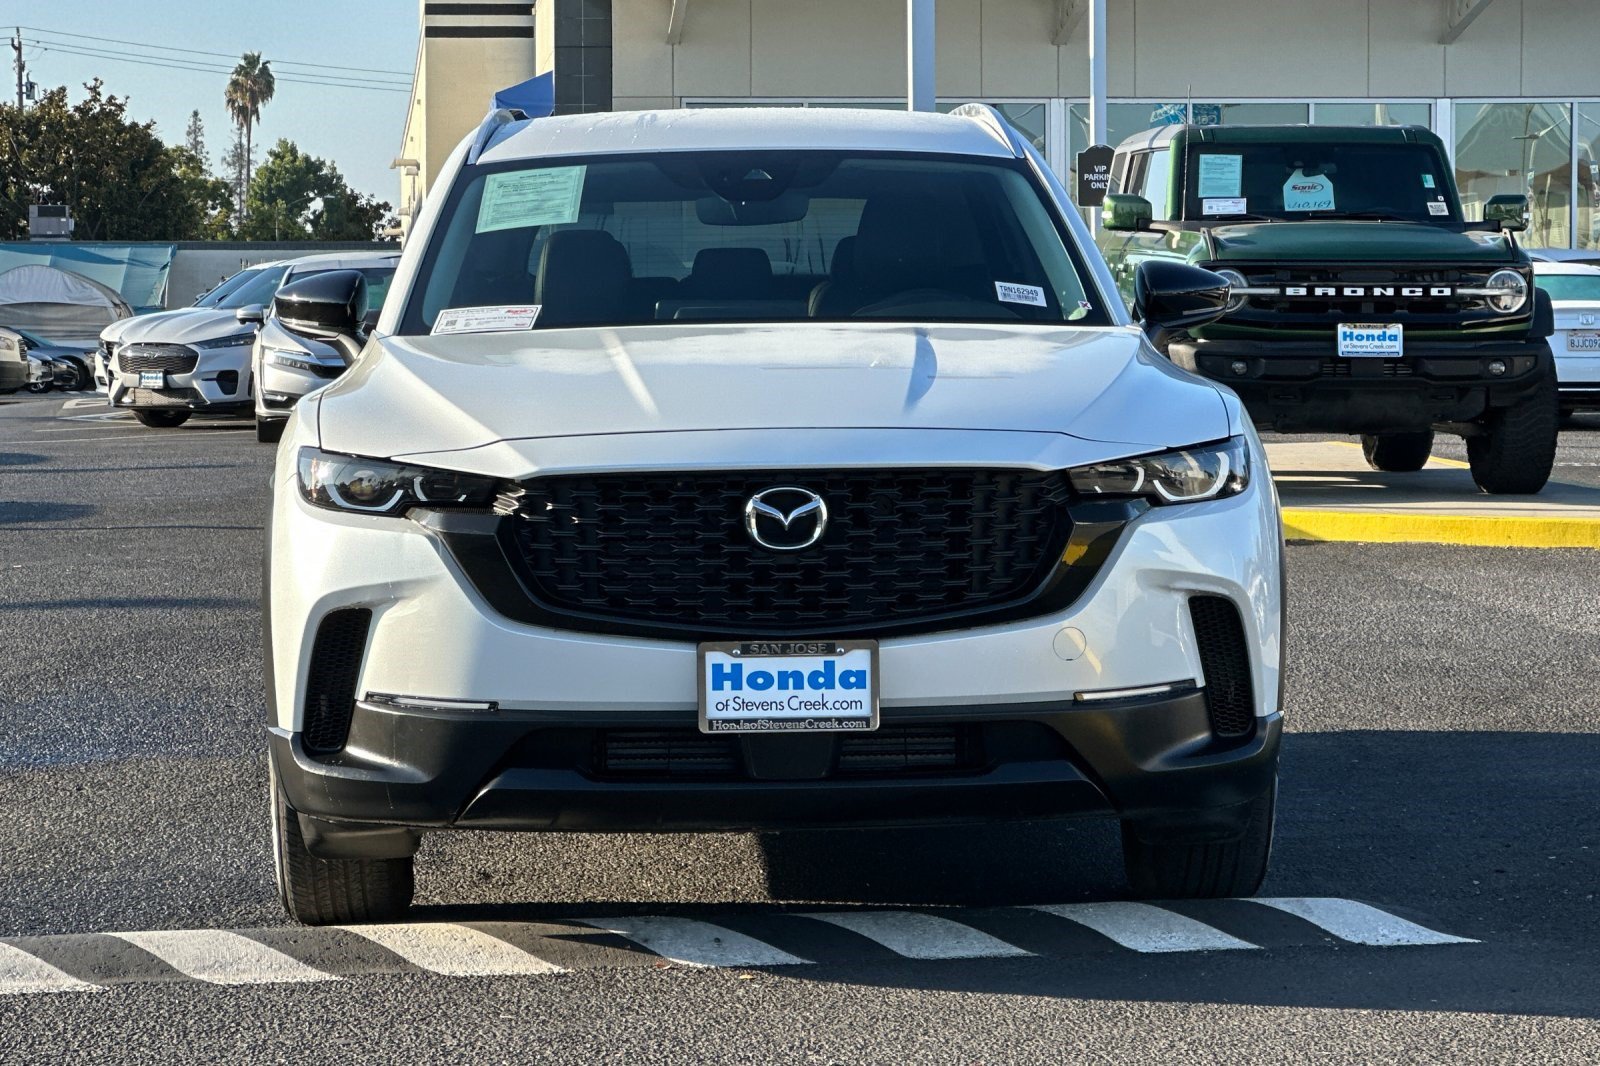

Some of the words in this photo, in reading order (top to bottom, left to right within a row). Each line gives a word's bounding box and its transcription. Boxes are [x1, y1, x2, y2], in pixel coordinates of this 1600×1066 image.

[1094, 165, 1107, 173] VIP
[1084, 173, 1111, 181] PARKIN
[1291, 183, 1320, 191] Sonic
[999, 285, 1039, 297] TRN162949
[1285, 287, 1451, 296] BRONCO
[1342, 330, 1398, 342] Honda
[750, 643, 782, 655] SAN
[785, 643, 828, 654] JOSE
[711, 660, 867, 691] Honda
[715, 699, 730, 712] of
[732, 695, 785, 712] Stevens
[787, 693, 863, 711] Creek.com
[712, 719, 867, 731] HondaofStevensCreek.com
